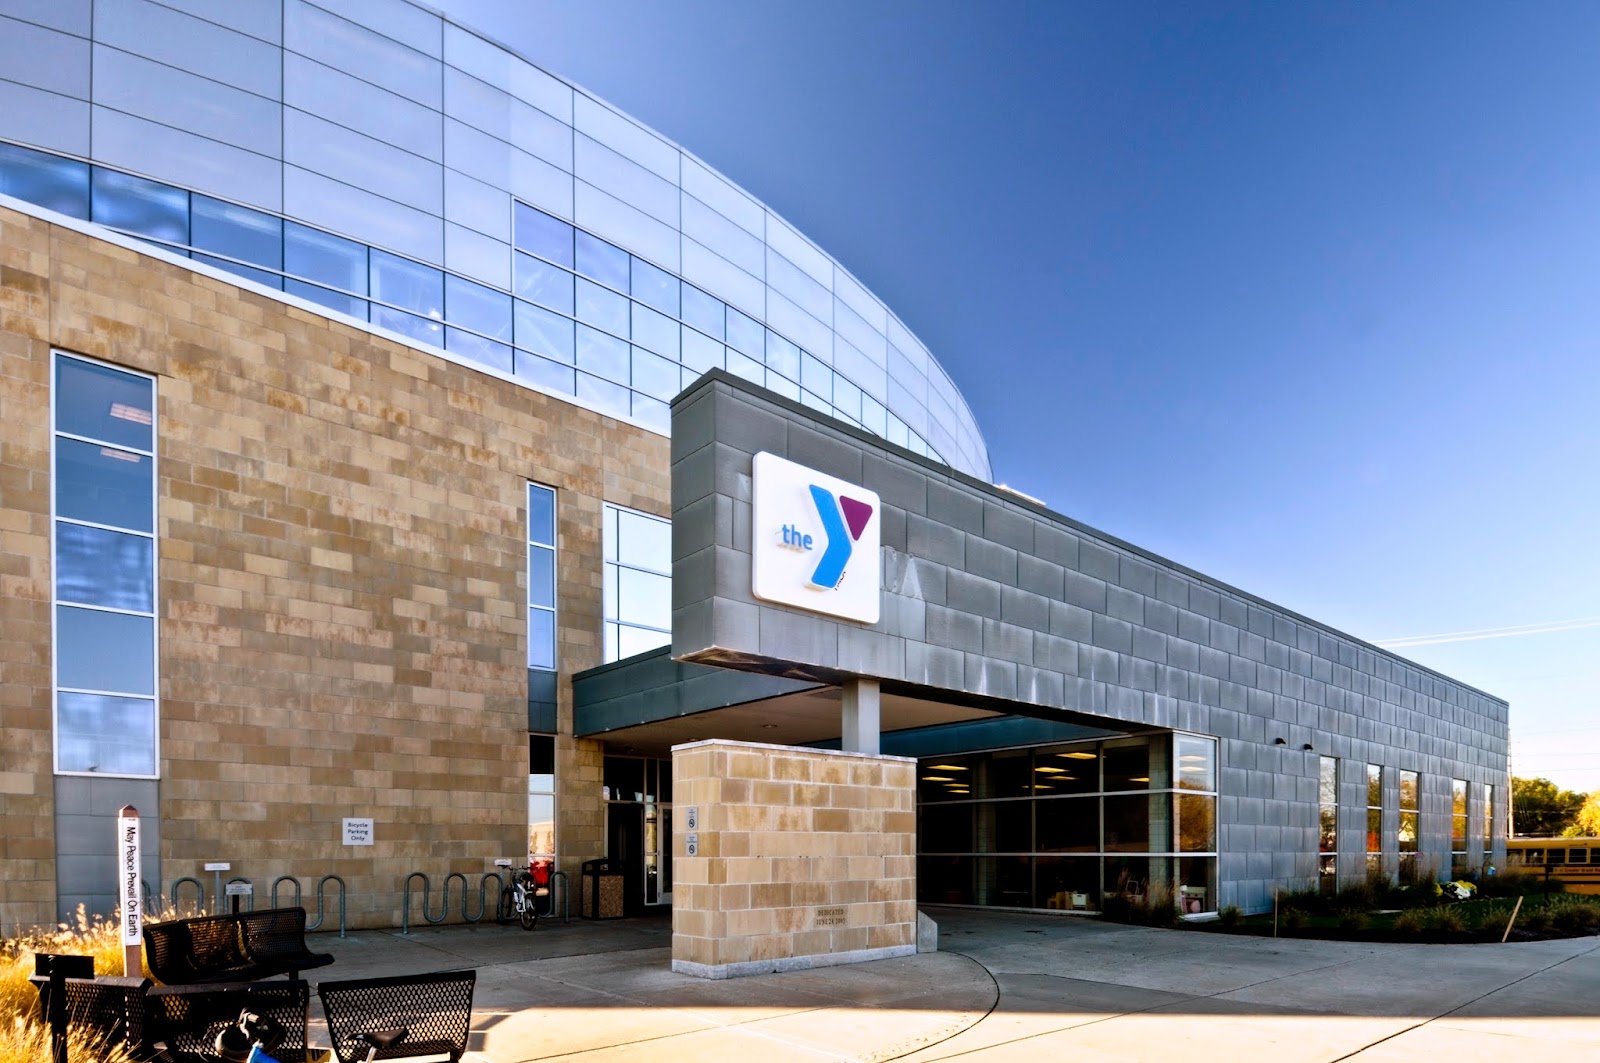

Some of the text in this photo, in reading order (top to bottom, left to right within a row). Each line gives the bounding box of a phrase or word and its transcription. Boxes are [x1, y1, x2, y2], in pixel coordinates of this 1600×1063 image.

[781, 524, 813, 550] the
[125, 826, 136, 844] May
[126, 845, 137, 871] Peace
[127, 872, 137, 899] Prevail
[127, 900, 138, 912] On
[817, 908, 844, 917] DEDICATED
[128, 914, 138, 937] Earth
